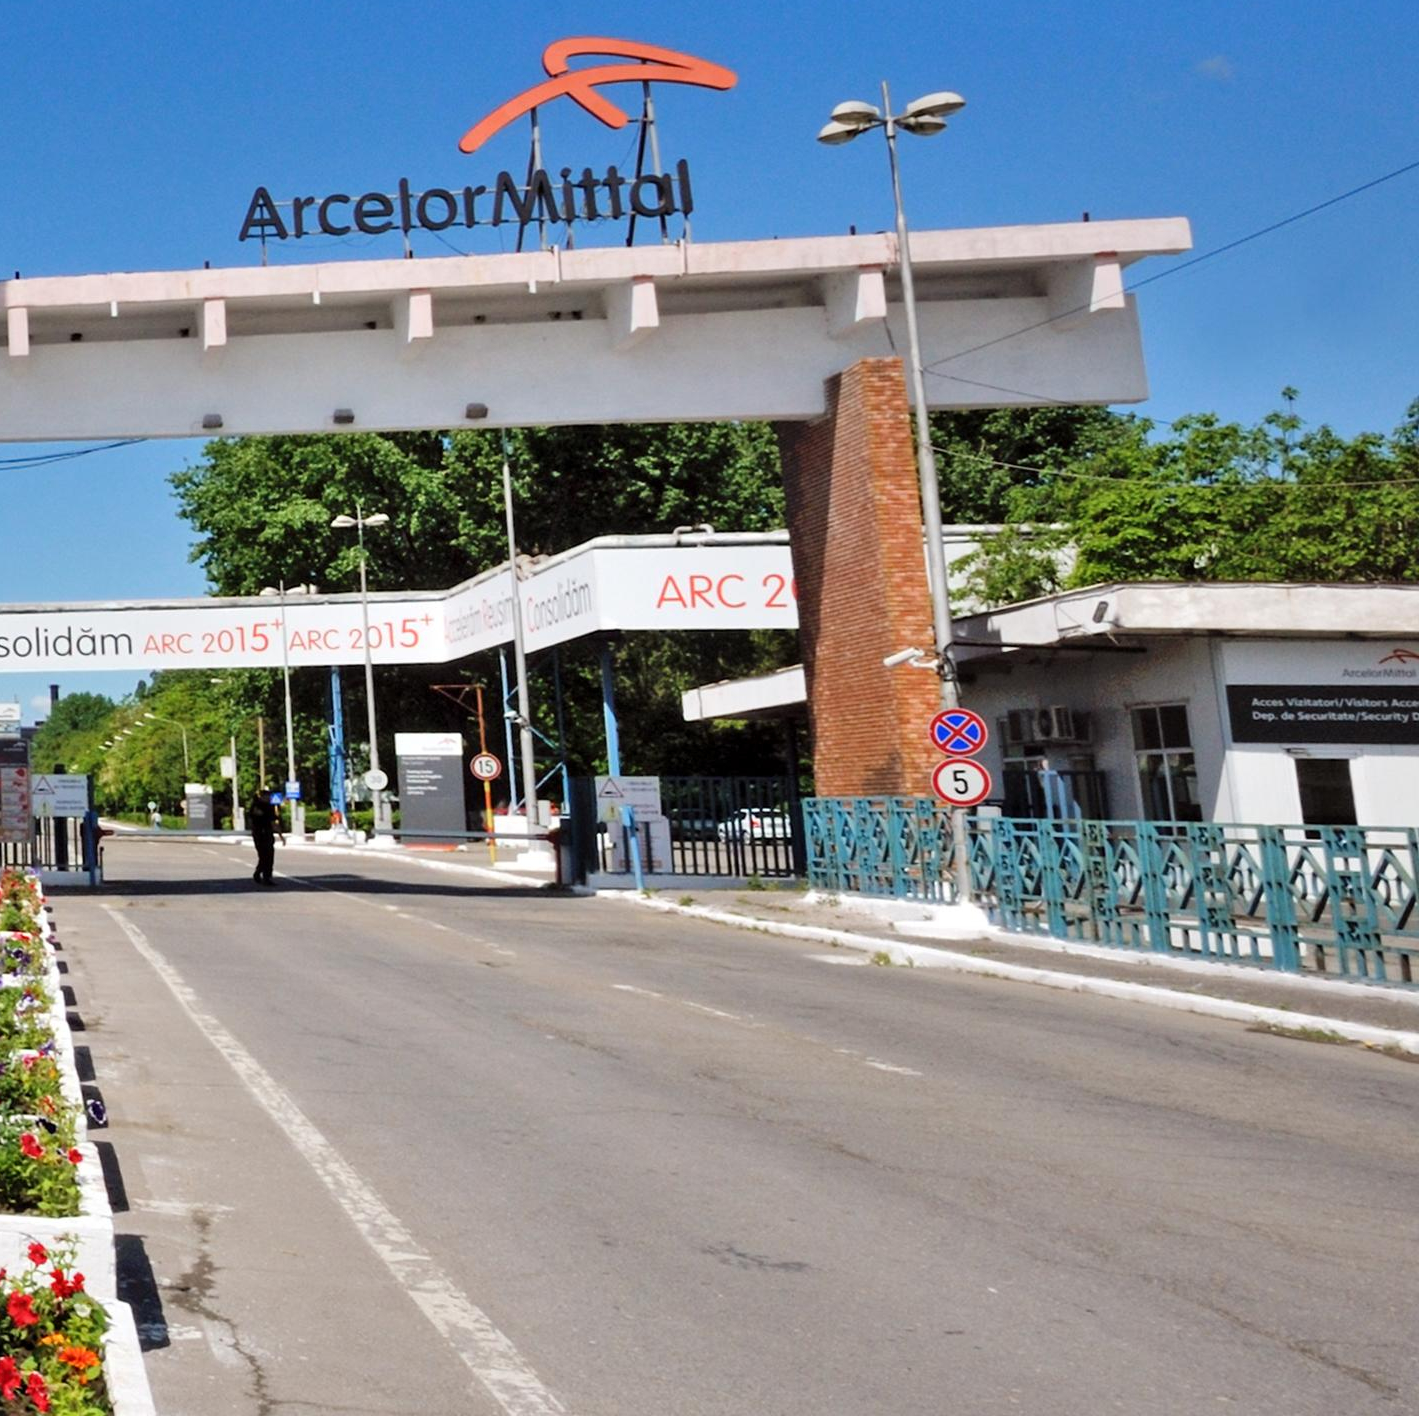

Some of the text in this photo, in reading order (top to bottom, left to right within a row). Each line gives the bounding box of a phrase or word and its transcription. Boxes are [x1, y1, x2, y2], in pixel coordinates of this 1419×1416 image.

[238, 158, 693, 242] ArcelorMittal
[656, 573, 747, 609] ARC
[526, 578, 593, 633] Consolidăm
[143, 632, 193, 655] ARC
[289, 629, 339, 651] ARC
[1342, 667, 1417, 678] ArcelorMittal
[1251, 697, 1284, 707] Acces
[1252, 711, 1278, 723] Dep.
[1280, 711, 1295, 721] de
[478, 759, 494, 774] 15
[953, 769, 969, 795] 5
